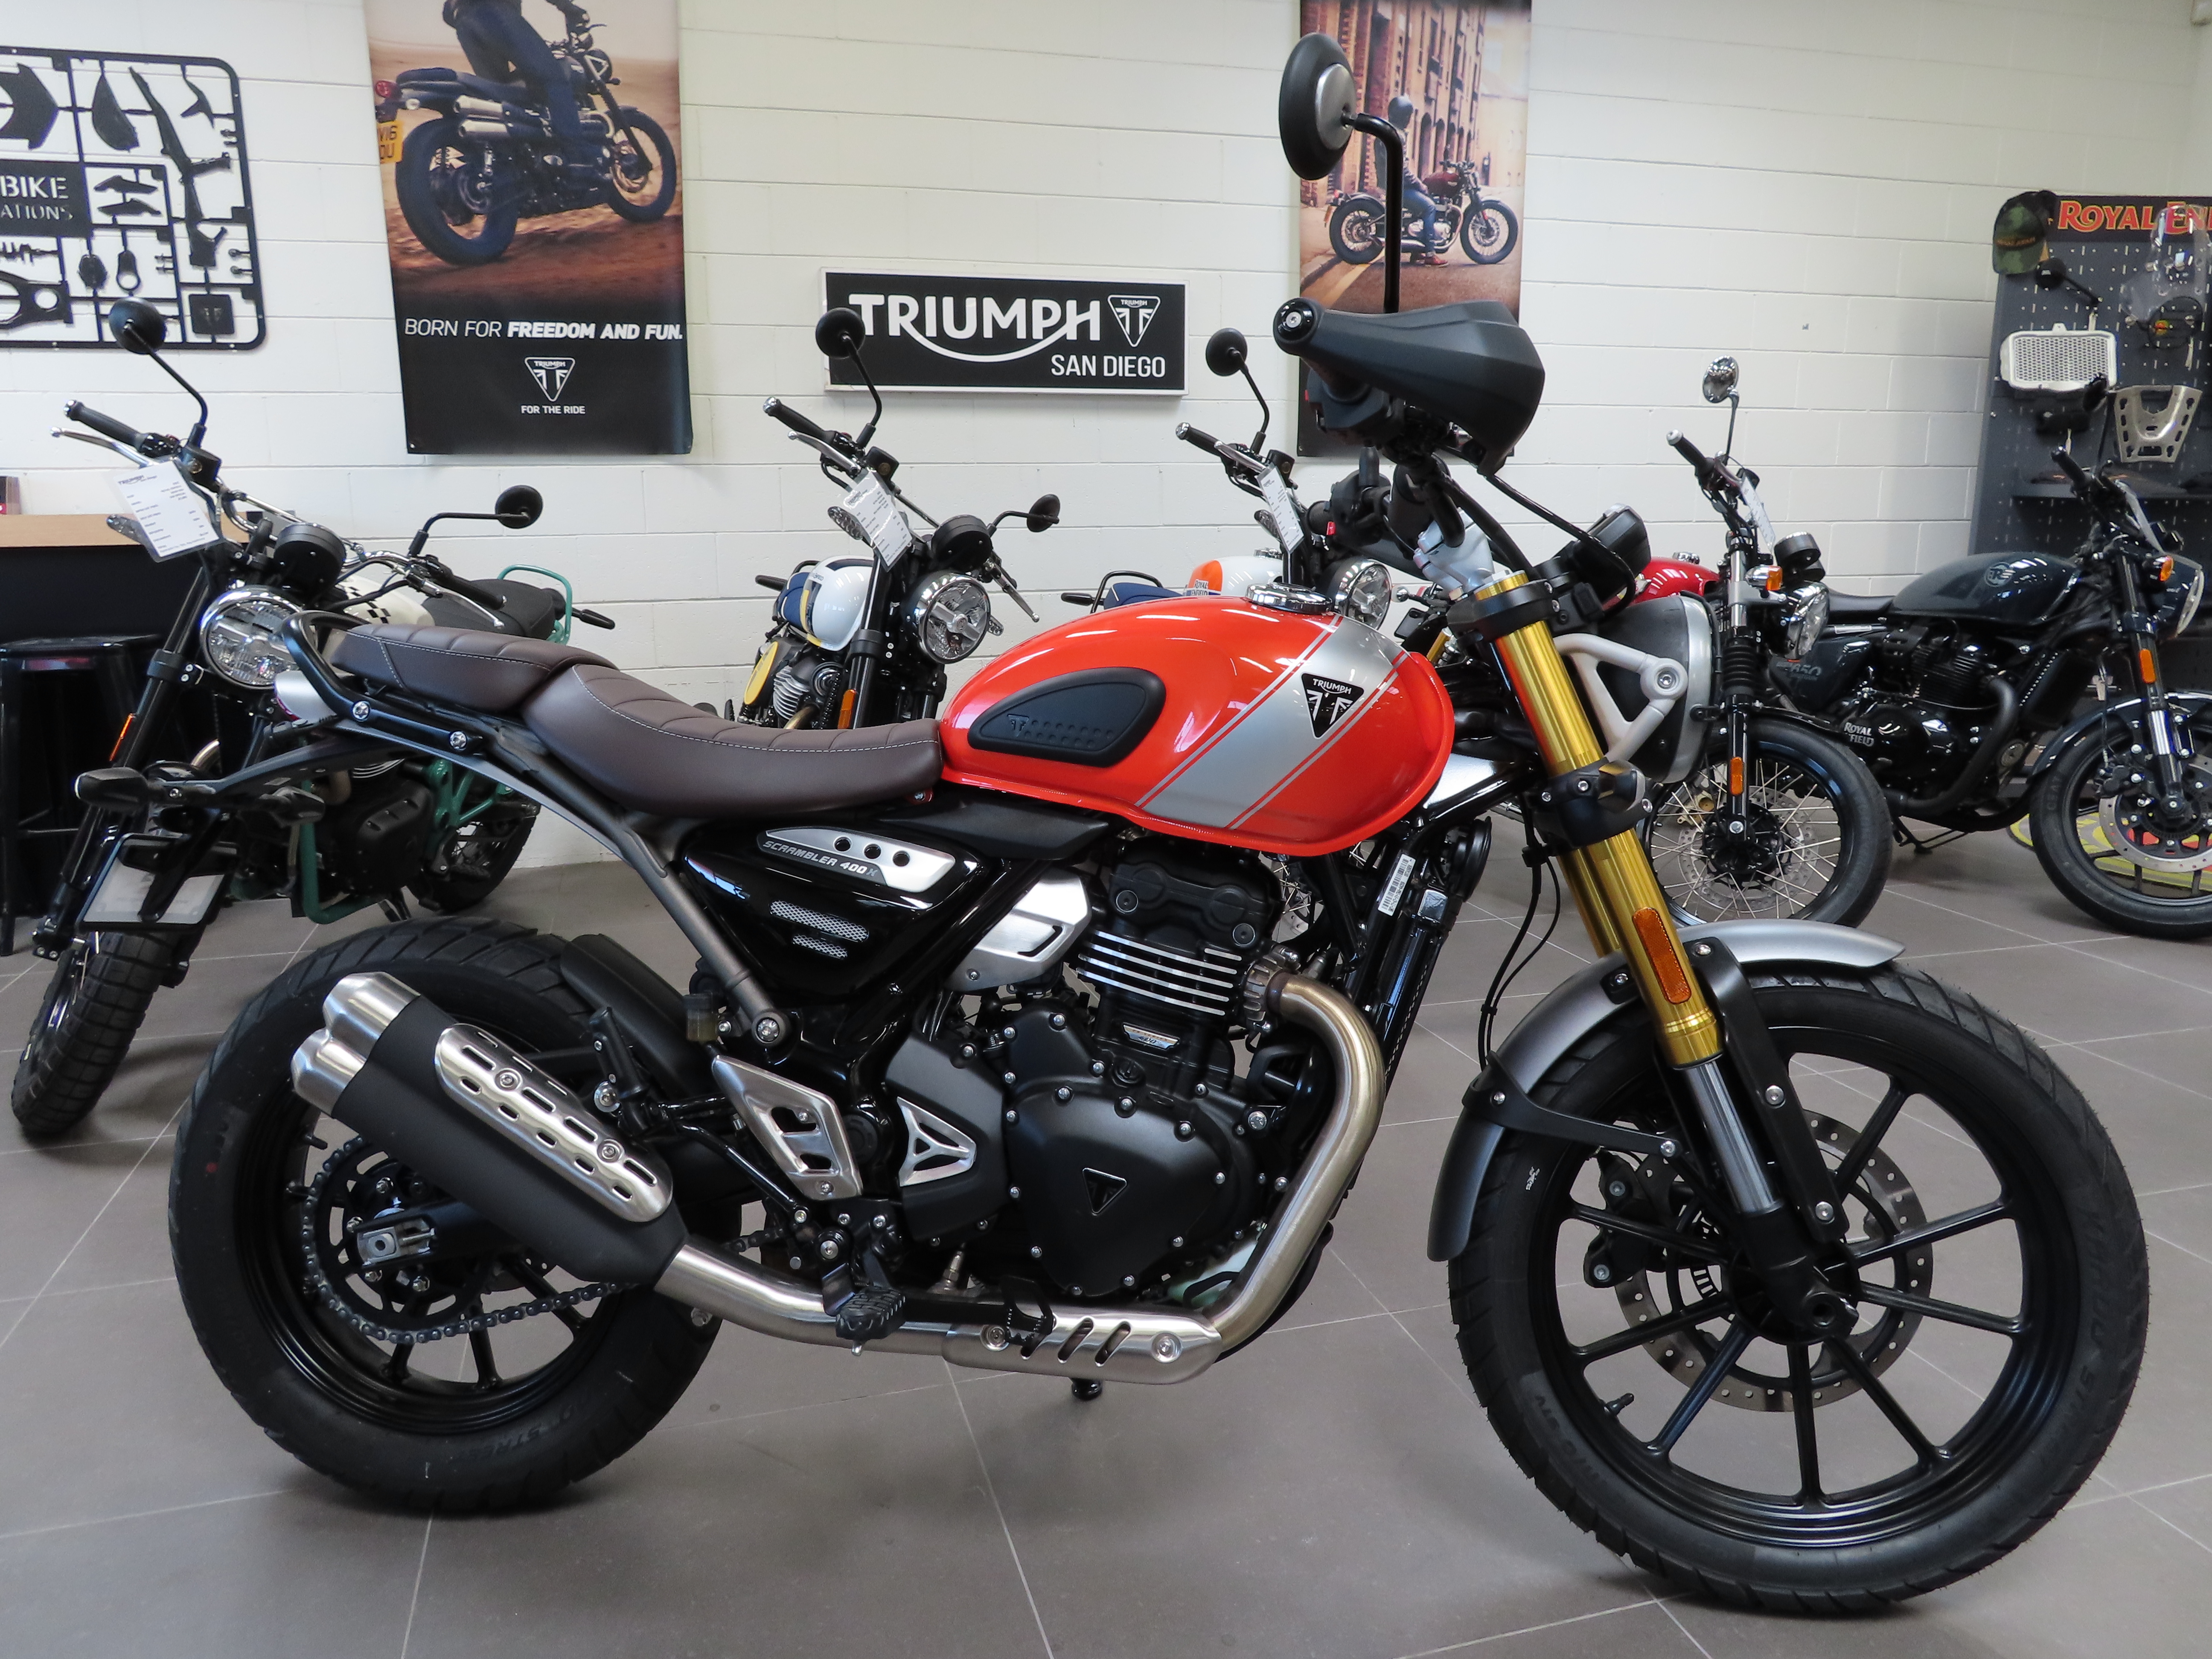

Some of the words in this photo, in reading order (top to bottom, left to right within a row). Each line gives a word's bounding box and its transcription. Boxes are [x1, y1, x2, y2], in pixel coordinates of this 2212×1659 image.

[0, 175, 69, 199] BIKE
[2058, 200, 2154, 233] ROYAL
[1120, 299, 1148, 308] TRIUMPH
[405, 318, 458, 336] BORN
[464, 320, 502, 337] FOR
[507, 321, 596, 339] FREEDOM
[600, 323, 640, 340] AND
[644, 324, 683, 340] FUN.
[849, 294, 1100, 362] TRIUMPH
[534, 361, 566, 370] TRIUMPH
[1051, 354, 1096, 376] SAN
[1103, 355, 1166, 378] DIEGO
[521, 405, 540, 414] FOR
[542, 405, 562, 414] THE
[564, 406, 585, 414] RIDE
[1194, 580, 1208, 589] ROYAL
[1313, 678, 1352, 695] TRIUMPH
[1844, 722, 1872, 736] ROYAL
[1845, 733, 1874, 747] FIELD
[763, 840, 838, 866] SCRAMBLER
